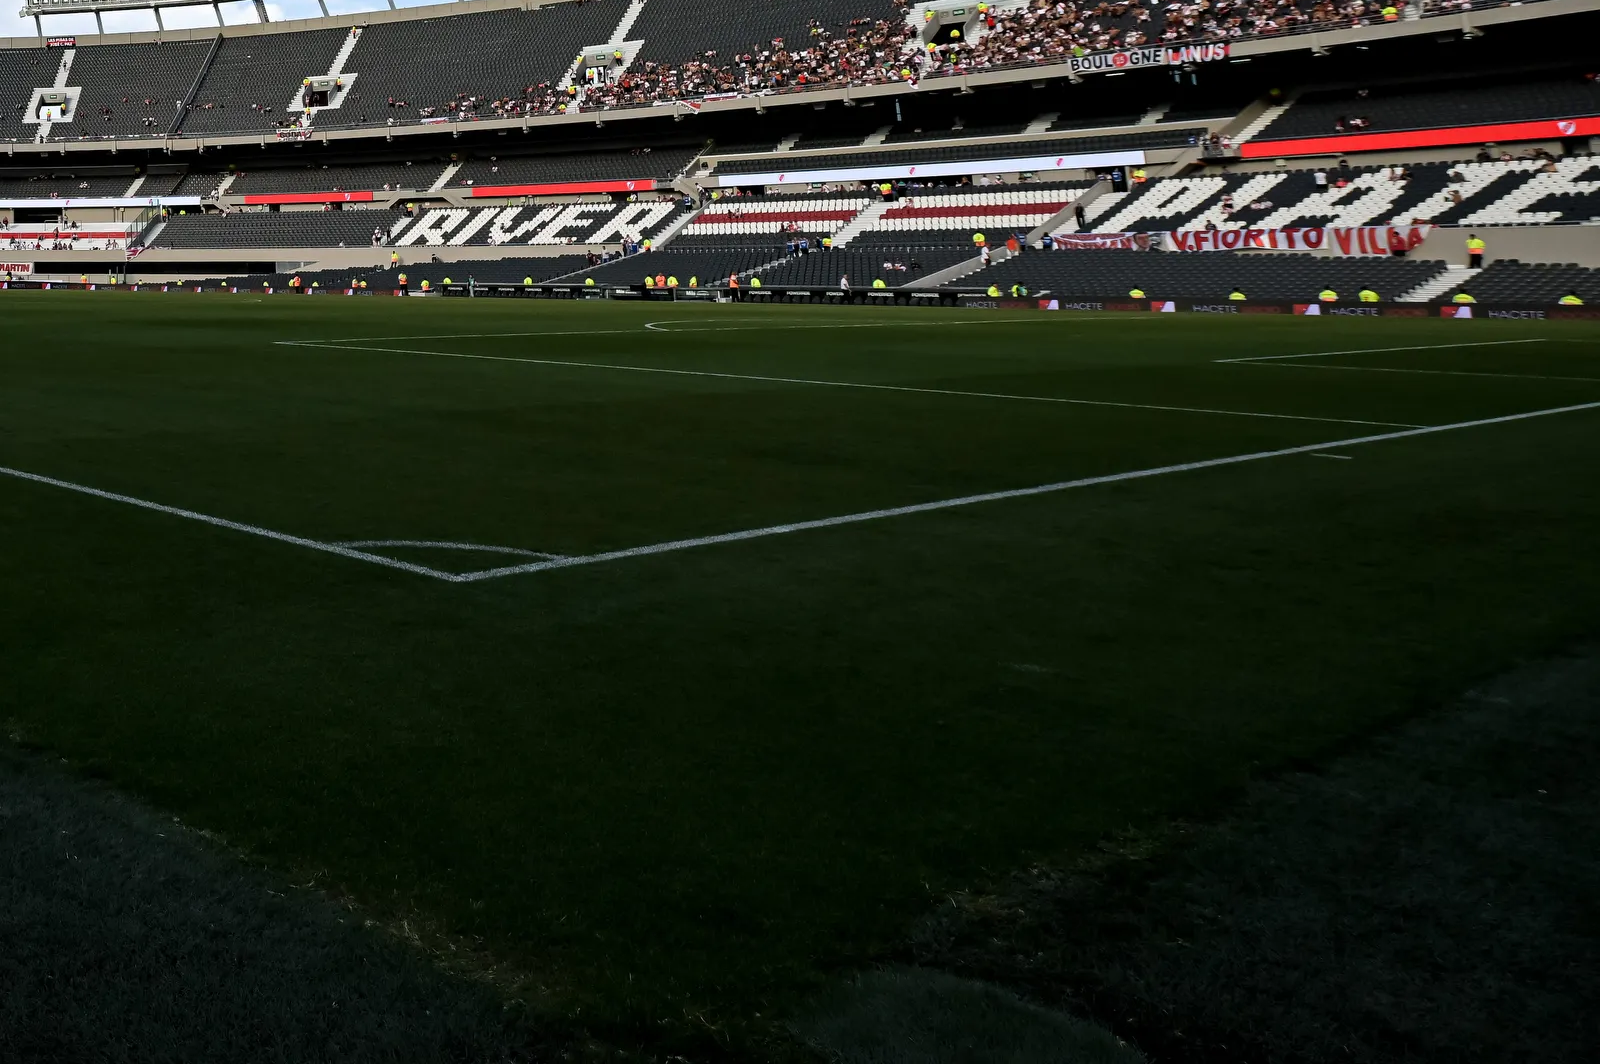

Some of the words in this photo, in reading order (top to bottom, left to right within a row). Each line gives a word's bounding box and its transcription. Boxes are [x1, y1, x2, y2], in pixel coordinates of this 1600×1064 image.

[1167, 43, 1226, 65] LANUS
[395, 201, 676, 246] RIVER
[1065, 303, 1103, 311] HACETE
[1193, 304, 1237, 313] HACETE
[1329, 307, 1379, 316] HACETE
[1488, 310, 1545, 320] HACETE
